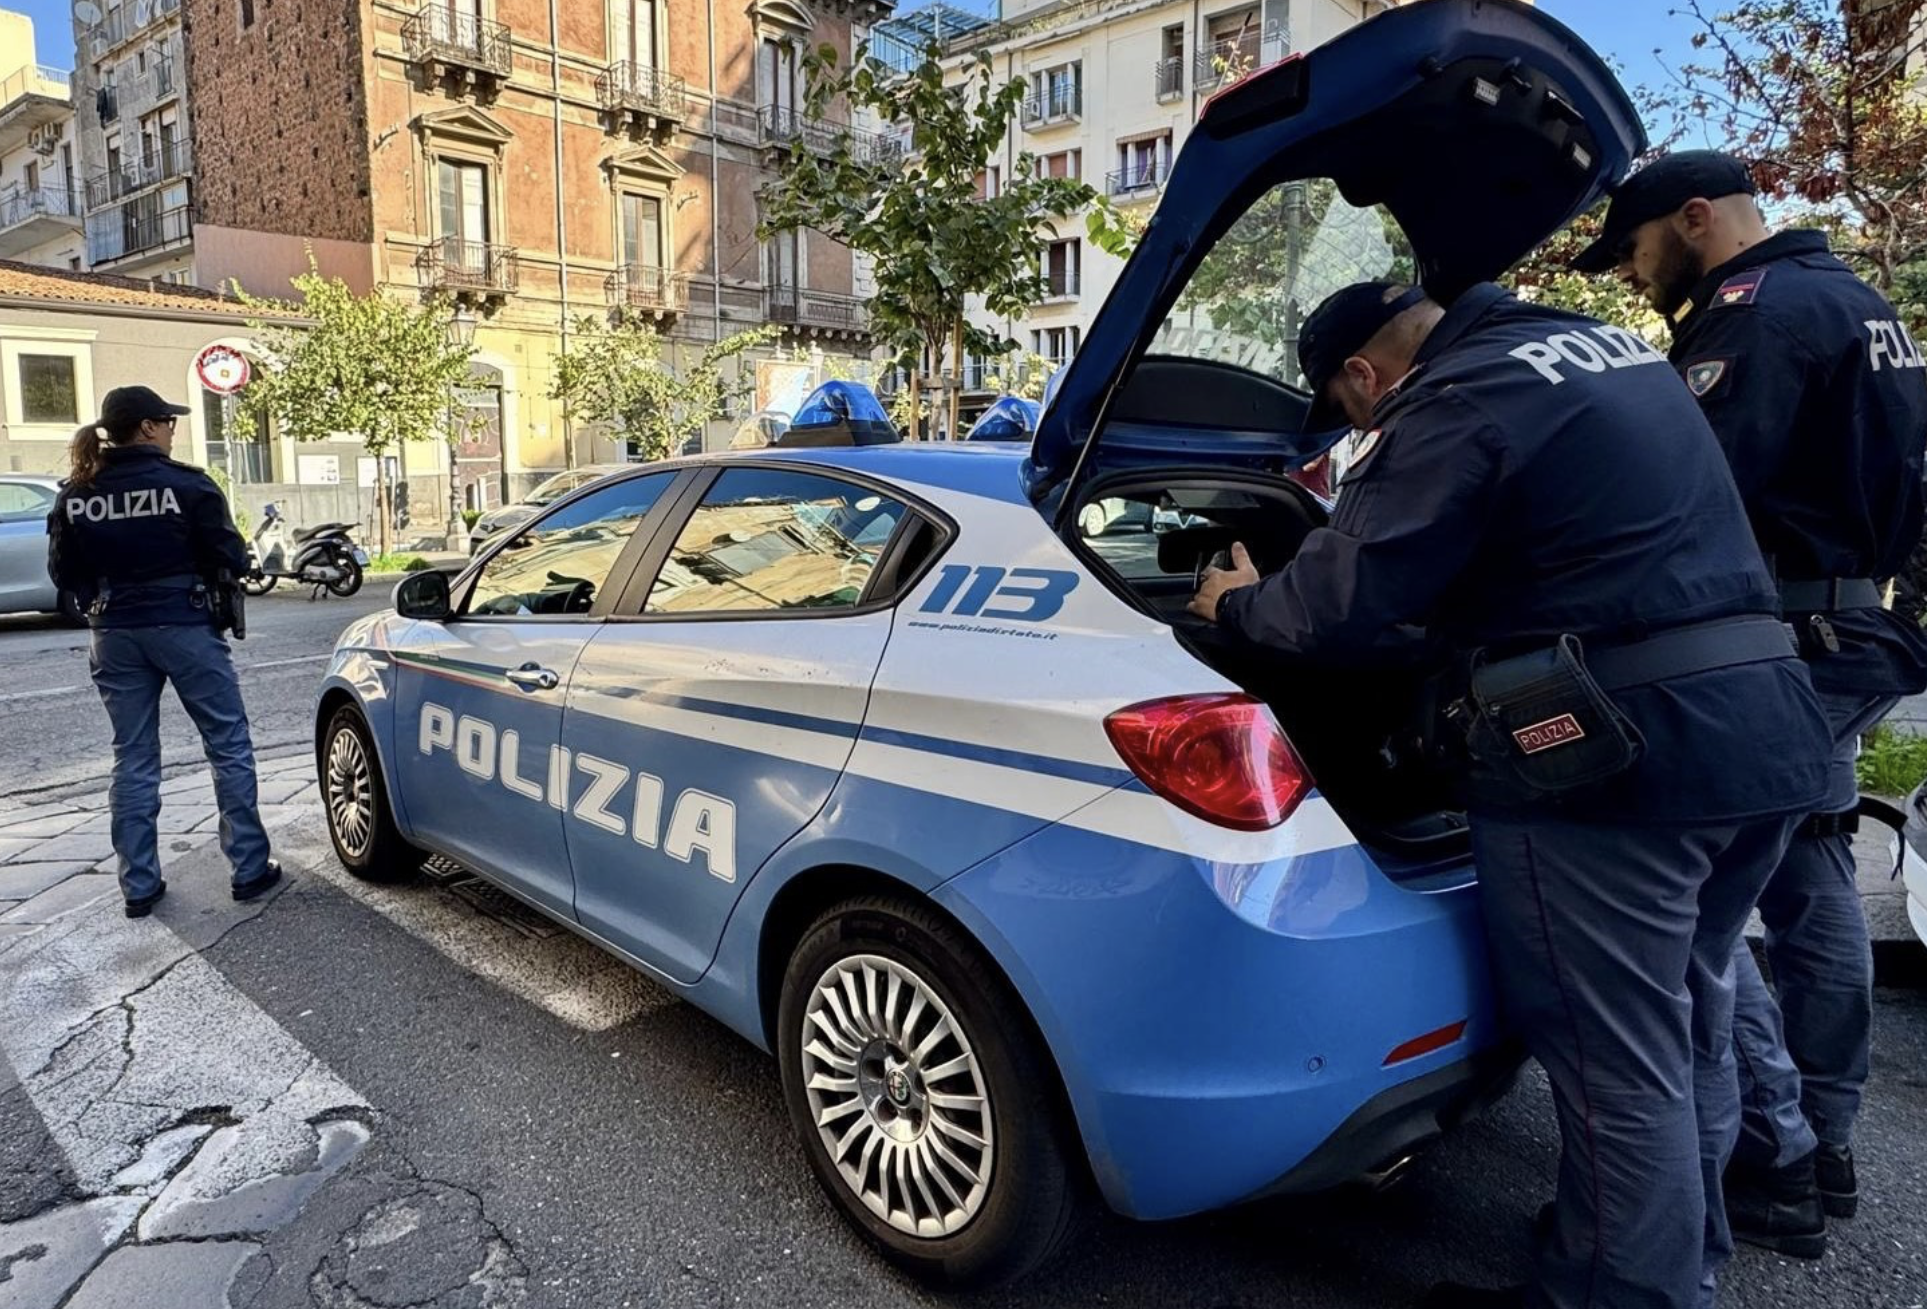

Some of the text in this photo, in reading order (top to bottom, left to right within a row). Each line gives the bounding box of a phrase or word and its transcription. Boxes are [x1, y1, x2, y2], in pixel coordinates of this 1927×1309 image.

[66, 487, 181, 524] POLIZIA
[918, 564, 1080, 622] 113
[1520, 721, 1577, 750] POLIZIA
[418, 702, 737, 883] POLIZIA
